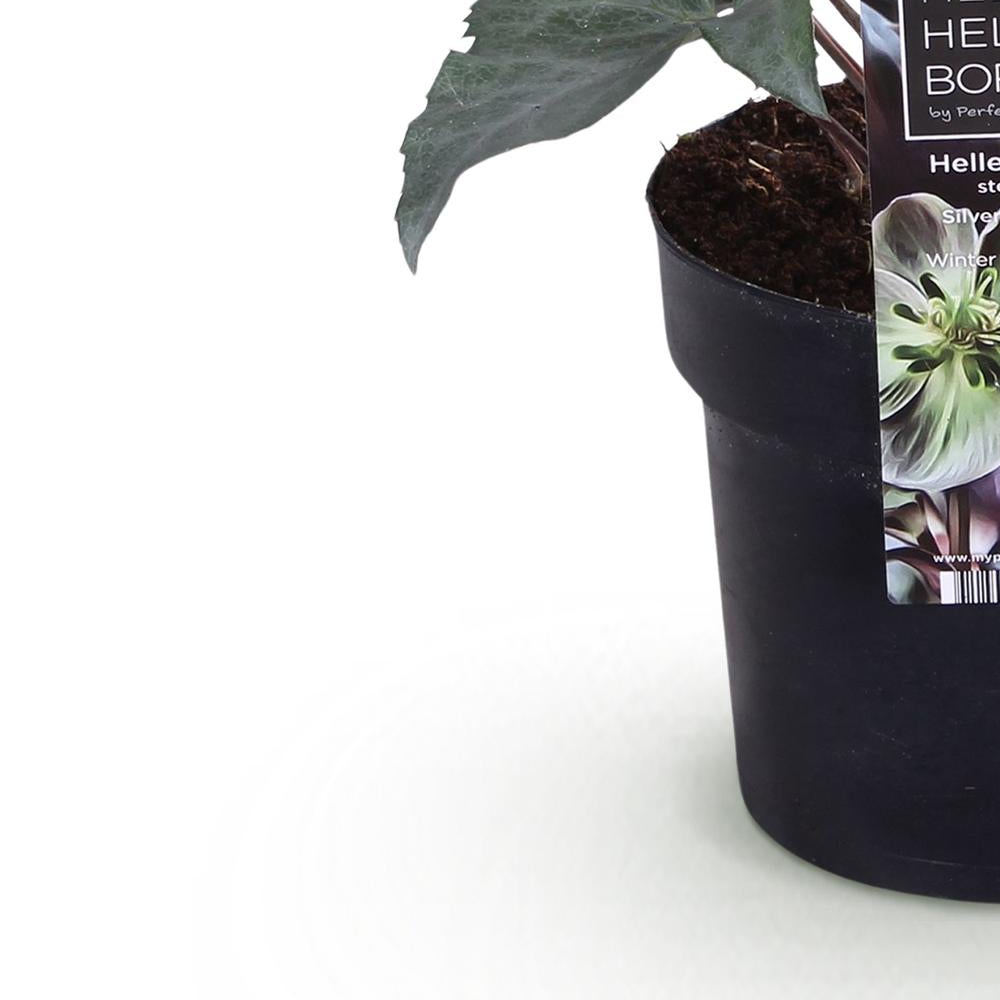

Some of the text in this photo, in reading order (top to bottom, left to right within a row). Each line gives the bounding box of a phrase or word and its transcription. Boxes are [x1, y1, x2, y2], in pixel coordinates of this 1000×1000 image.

[929, 106, 952, 122] by
[941, 209, 1000, 225] Silver
[926, 252, 997, 268] Winter
